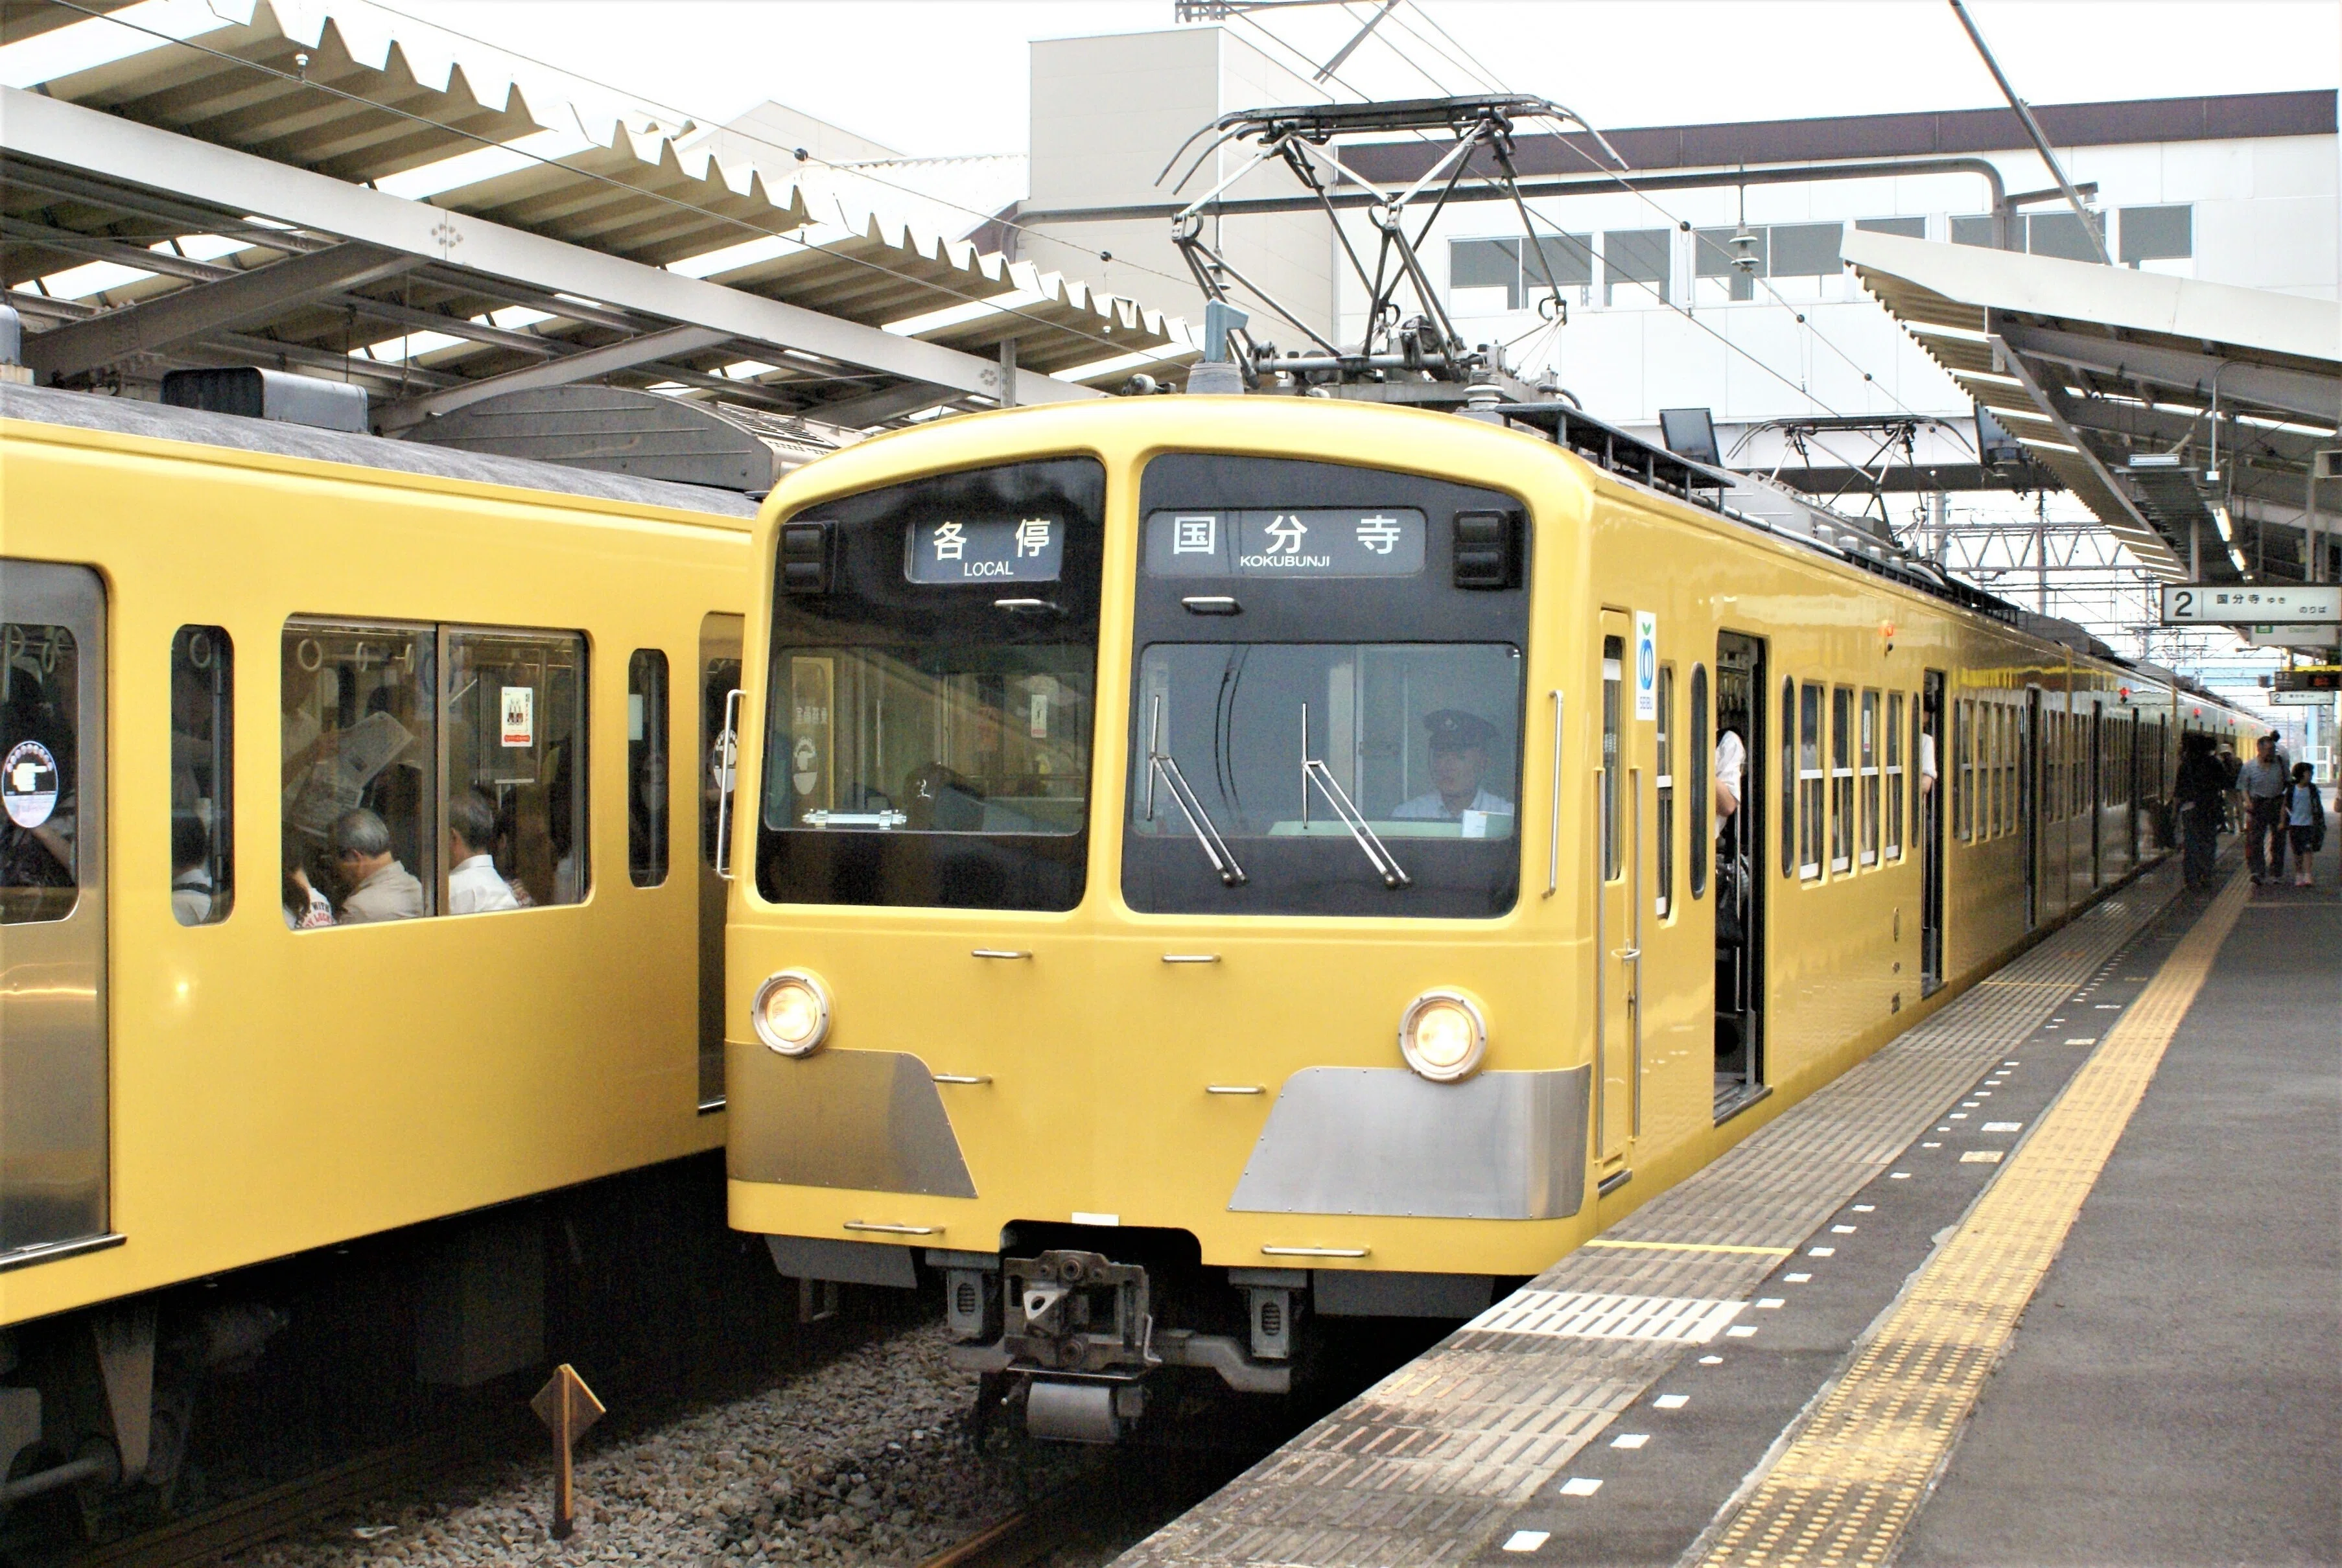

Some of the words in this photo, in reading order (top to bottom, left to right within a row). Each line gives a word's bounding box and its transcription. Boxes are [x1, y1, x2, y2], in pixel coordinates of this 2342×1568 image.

[933, 519, 1050, 560] 各停
[1173, 515, 1401, 554] 国分寺
[965, 561, 1014, 576] LOCAL
[1240, 556, 1329, 567] KOKUBUNJI
[2175, 591, 2192, 616] 2
[2274, 694, 2281, 703] 2
